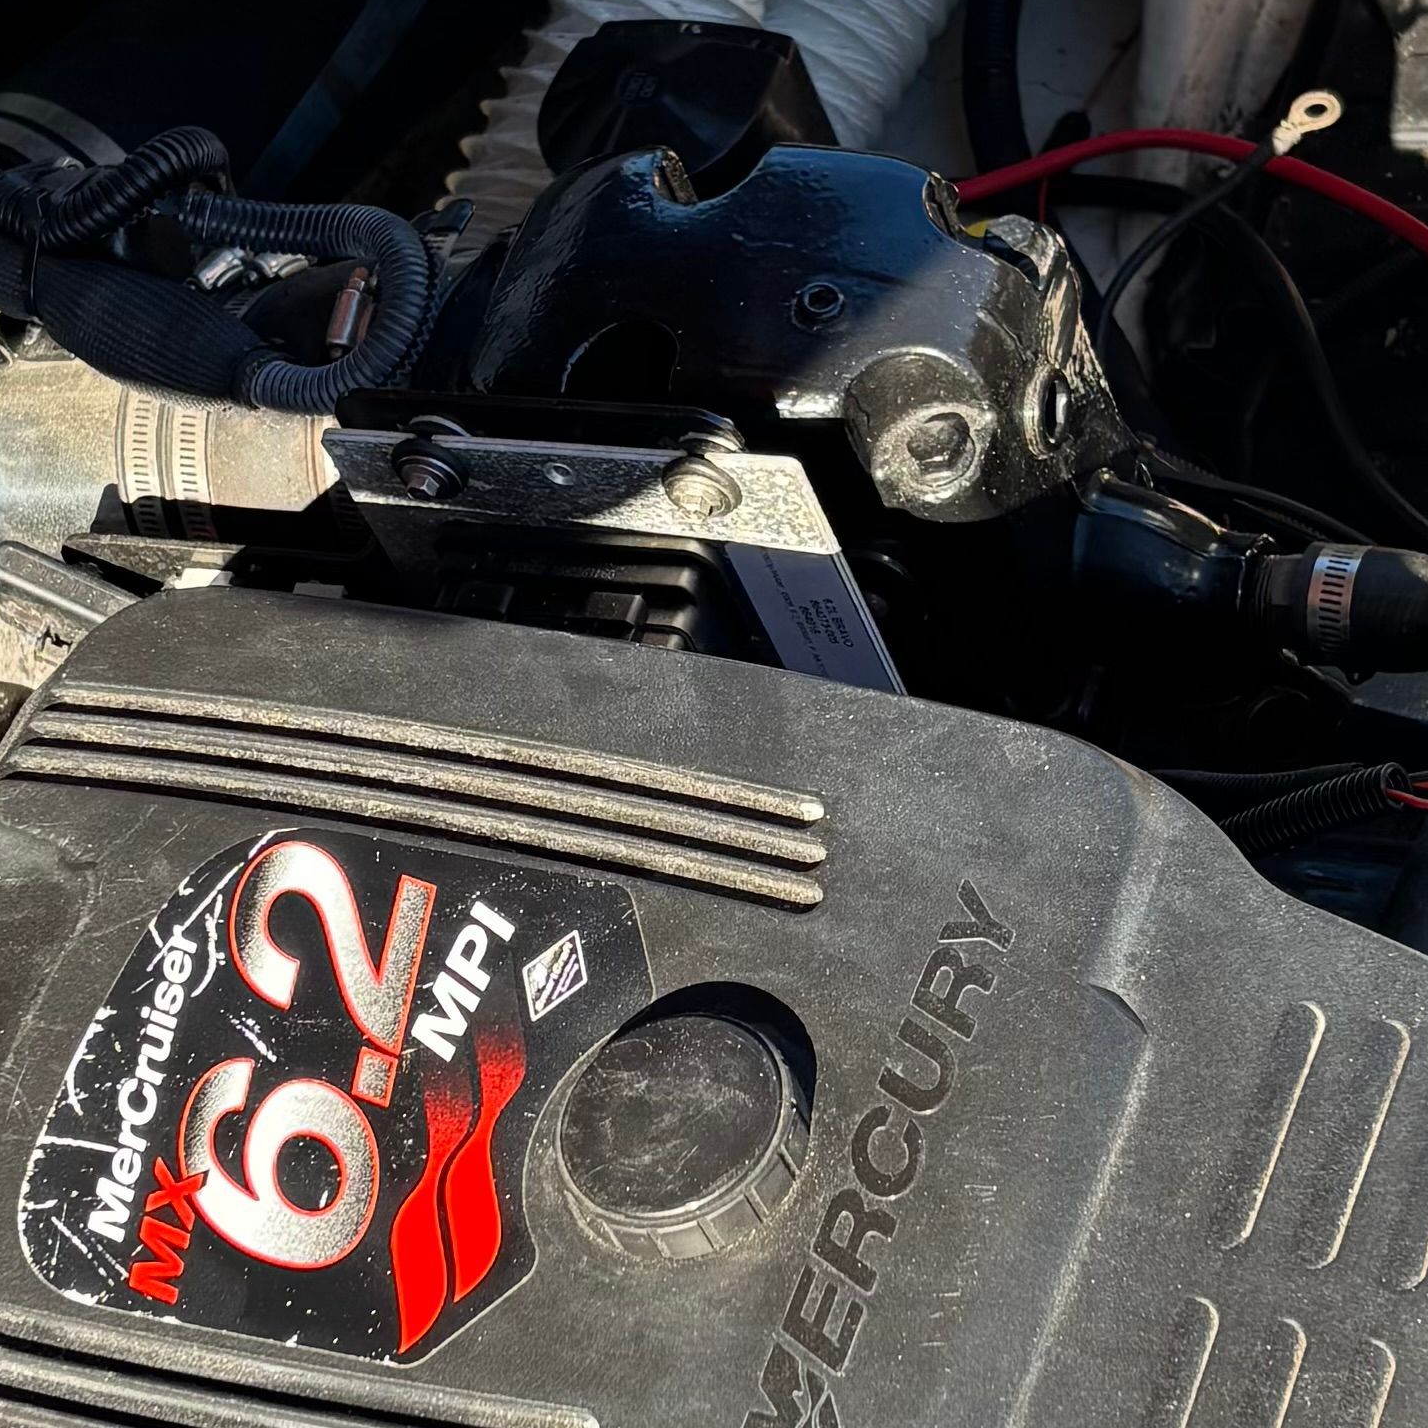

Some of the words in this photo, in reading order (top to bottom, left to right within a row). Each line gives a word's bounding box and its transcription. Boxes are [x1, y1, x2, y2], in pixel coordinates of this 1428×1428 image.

[87, 922, 199, 1243] MerCruiser
[177, 840, 438, 1270] 6.2
[410, 900, 516, 1063] MPI
[128, 1157, 209, 1305] MX
